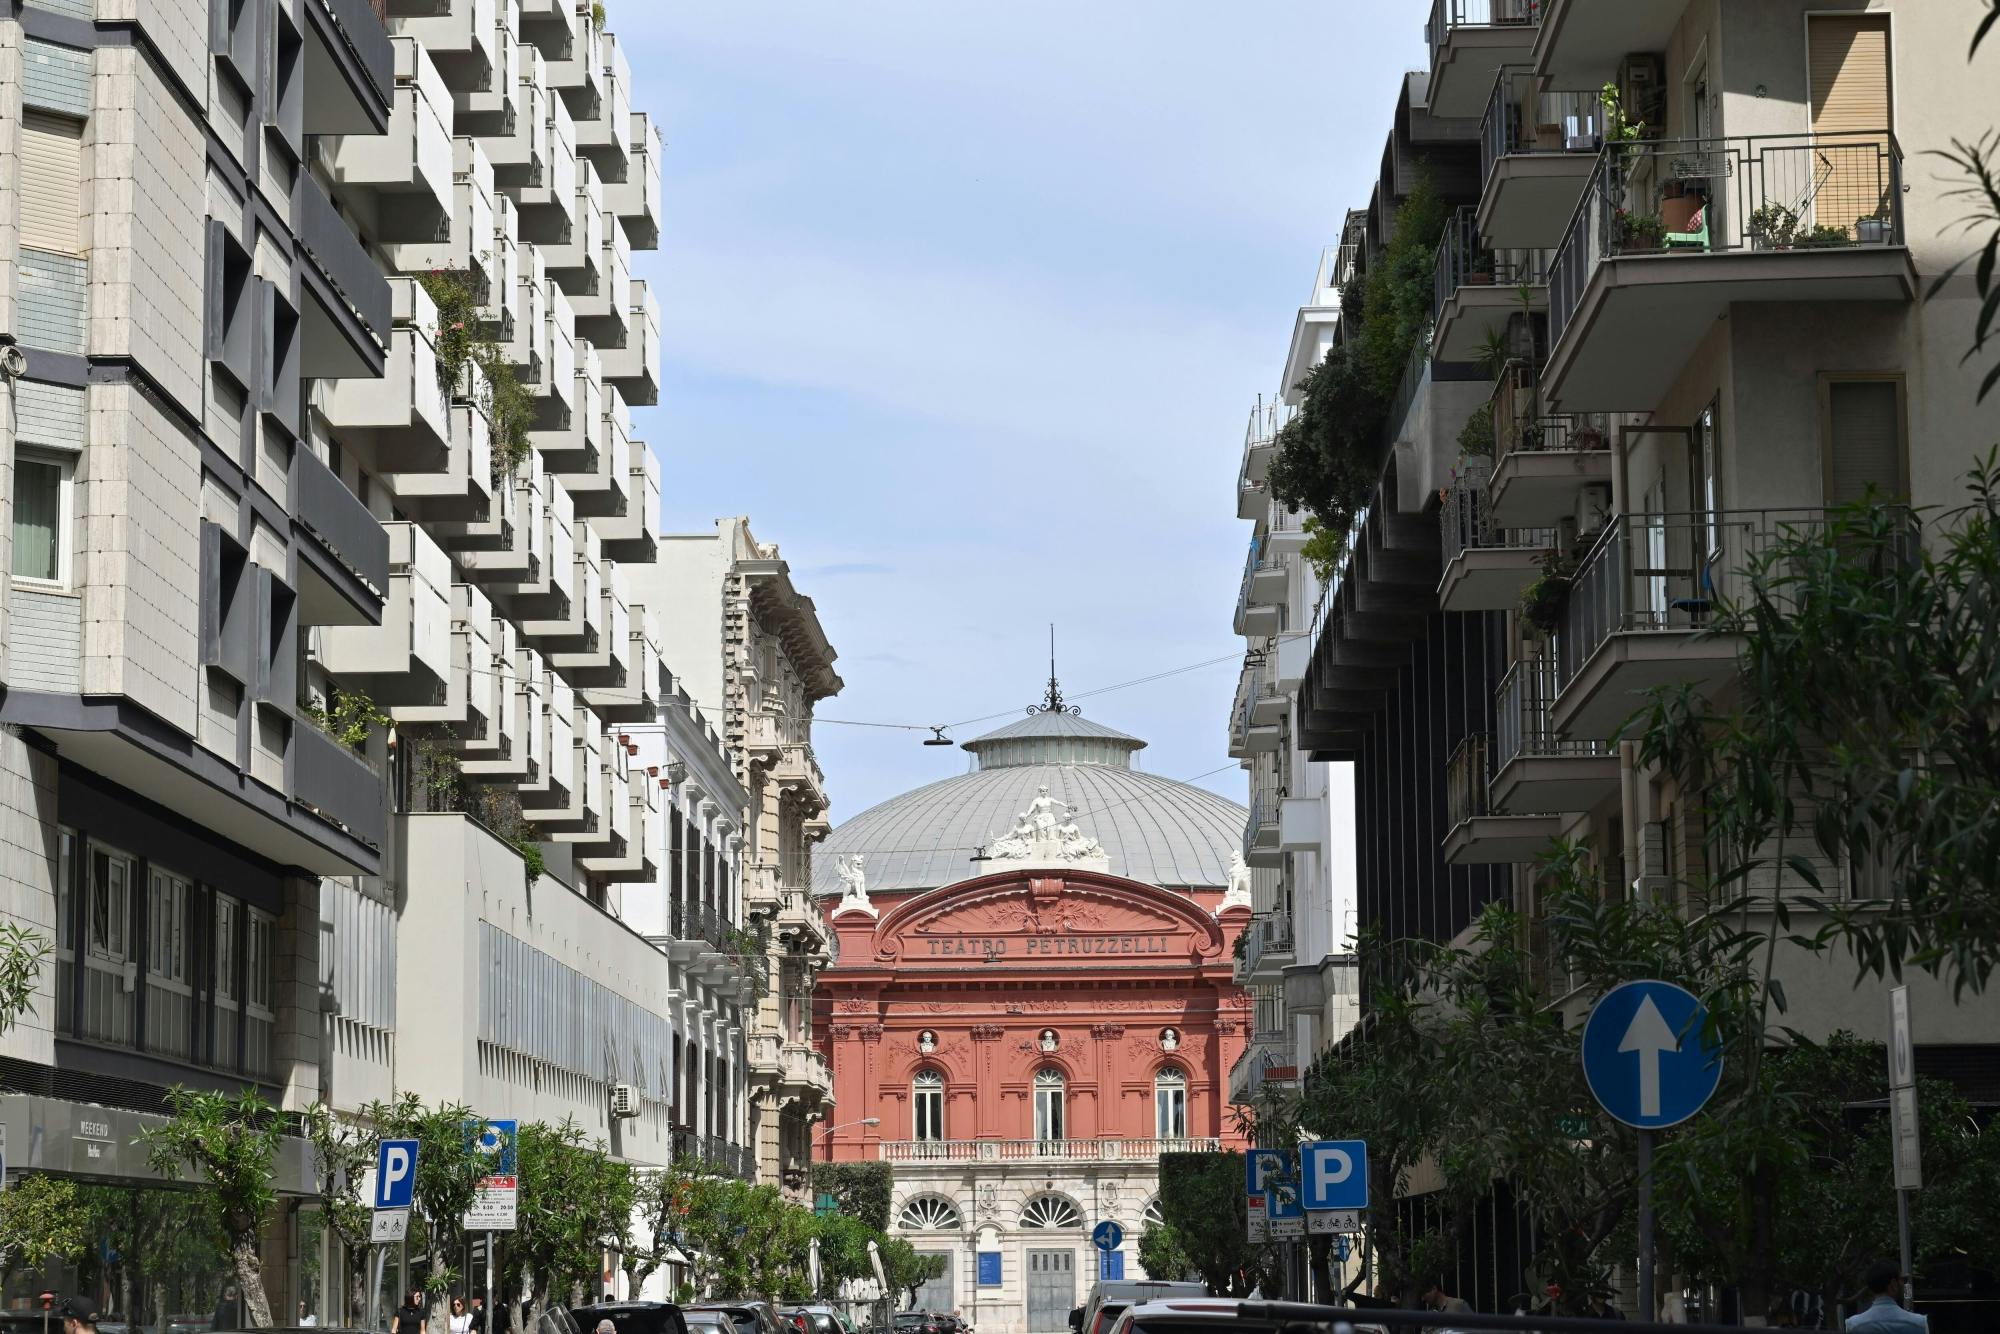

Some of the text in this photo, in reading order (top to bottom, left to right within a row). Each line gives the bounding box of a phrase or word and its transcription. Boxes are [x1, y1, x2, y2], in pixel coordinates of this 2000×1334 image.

[927, 937, 1167, 955] TEATRO PETRUZZELLI
[80, 1120, 108, 1137] WEEKEND
[384, 1147, 409, 1200] P
[1256, 1154, 1282, 1190] P
[1315, 1149, 1353, 1202] P
[1276, 1186, 1296, 1215] P
